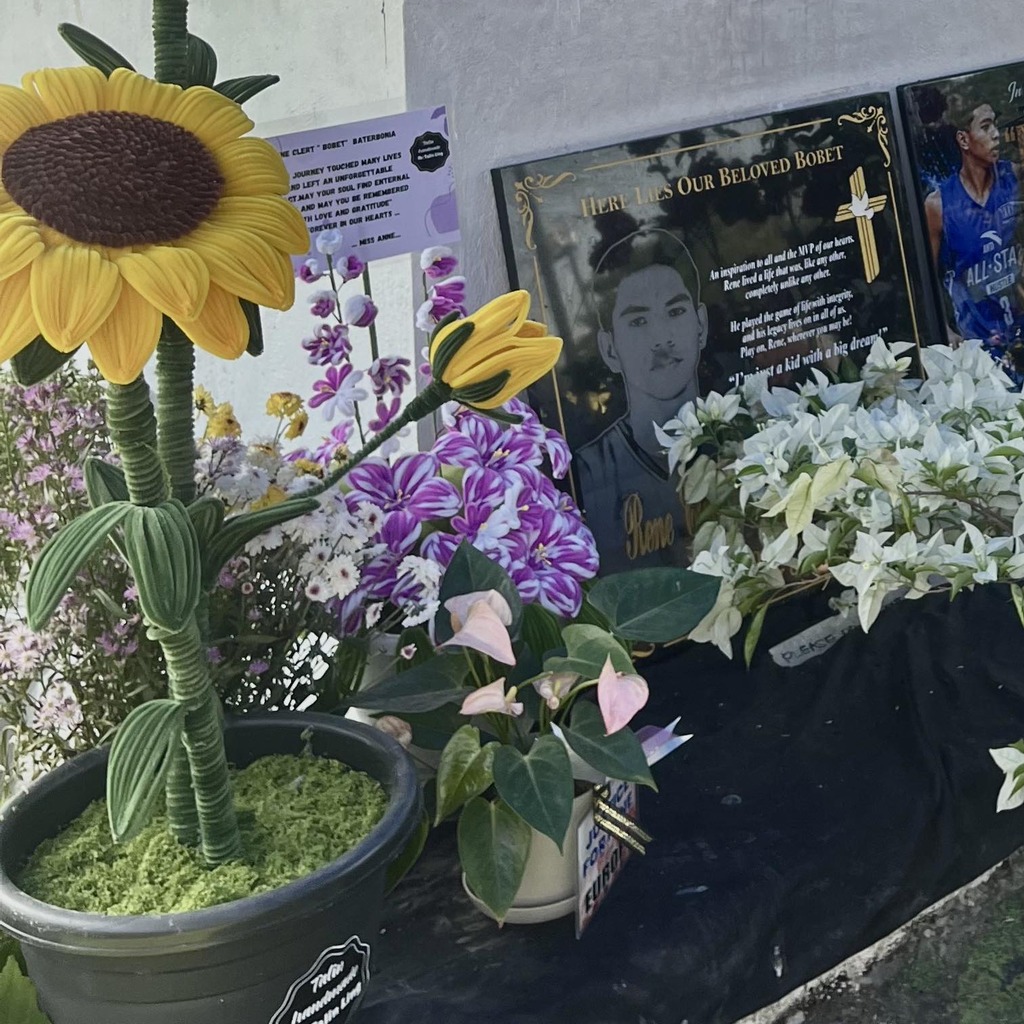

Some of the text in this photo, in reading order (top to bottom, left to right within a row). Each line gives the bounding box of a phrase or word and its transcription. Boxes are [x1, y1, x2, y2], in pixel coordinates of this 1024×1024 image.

[1008, 80, 1022, 104] In
[292, 146, 315, 156] CLERT
[352, 130, 396, 145] BATERBONIA
[290, 165, 394, 191] ND LEFT AN UNFORGETTABLE
[292, 152, 402, 179] JOURNEY TOUCHED MANY LIVES
[634, 183, 673, 206] LIES
[677, 174, 716, 196] OUR
[718, 157, 792, 188] BELOVED
[795, 144, 845, 169] BOBET
[300, 184, 410, 212] AND MAY YOU BE REMEMBERED
[316, 188, 336, 198] YOUR
[338, 185, 356, 194] SOUL
[357, 180, 372, 190] FIND
[374, 174, 410, 188] ENTERNAL
[314, 212, 333, 222] LOVE
[335, 208, 350, 216] AND
[340, 220, 348, 228] IN
[349, 218, 362, 226] OUR
[365, 210, 392, 222] HEARTS
[360, 236, 376, 246] MISS
[710, 270, 720, 280] An
[720, 260, 756, 278] inspiration
[756, 259, 764, 268] to
[764, 254, 773, 266] all
[774, 250, 786, 264] and
[787, 248, 798, 260] the
[798, 243, 815, 256] MVP
[815, 240, 822, 252] of
[823, 240, 834, 249] our
[724, 279, 740, 292] Rene
[742, 273, 758, 286] lived
[758, 274, 763, 282] a
[764, 269, 774, 282] life
[776, 266, 788, 278] that
[804, 258, 816, 269] like
[816, 254, 828, 266] any
[744, 282, 780, 300] completely
[780, 276, 800, 290] unlike
[800, 272, 812, 284] any
[730, 321, 740, 332] He
[742, 312, 763, 332] played
[764, 311, 774, 322] the
[774, 307, 792, 322] game
[793, 302, 800, 316] of
[800, 299, 812, 314] life
[811, 294, 826, 309] with
[742, 329, 756, 343] and
[756, 327, 766, 339] his
[766, 321, 788, 338] legacy
[788, 316, 802, 330] lives
[804, 315, 812, 325] on
[812, 311, 820, 322] in
[820, 306, 829, 320] all
[830, 304, 838, 318] of
[740, 346, 755, 358] Play
[787, 328, 816, 344] wherever
[816, 325, 828, 338] you
[828, 321, 842, 334] may
[776, 363, 783, 374] a
[784, 355, 800, 372] kid
[802, 347, 823, 366] with
[825, 348, 832, 359] a
[833, 342, 849, 358] big
[624, 492, 674, 560] Rene
